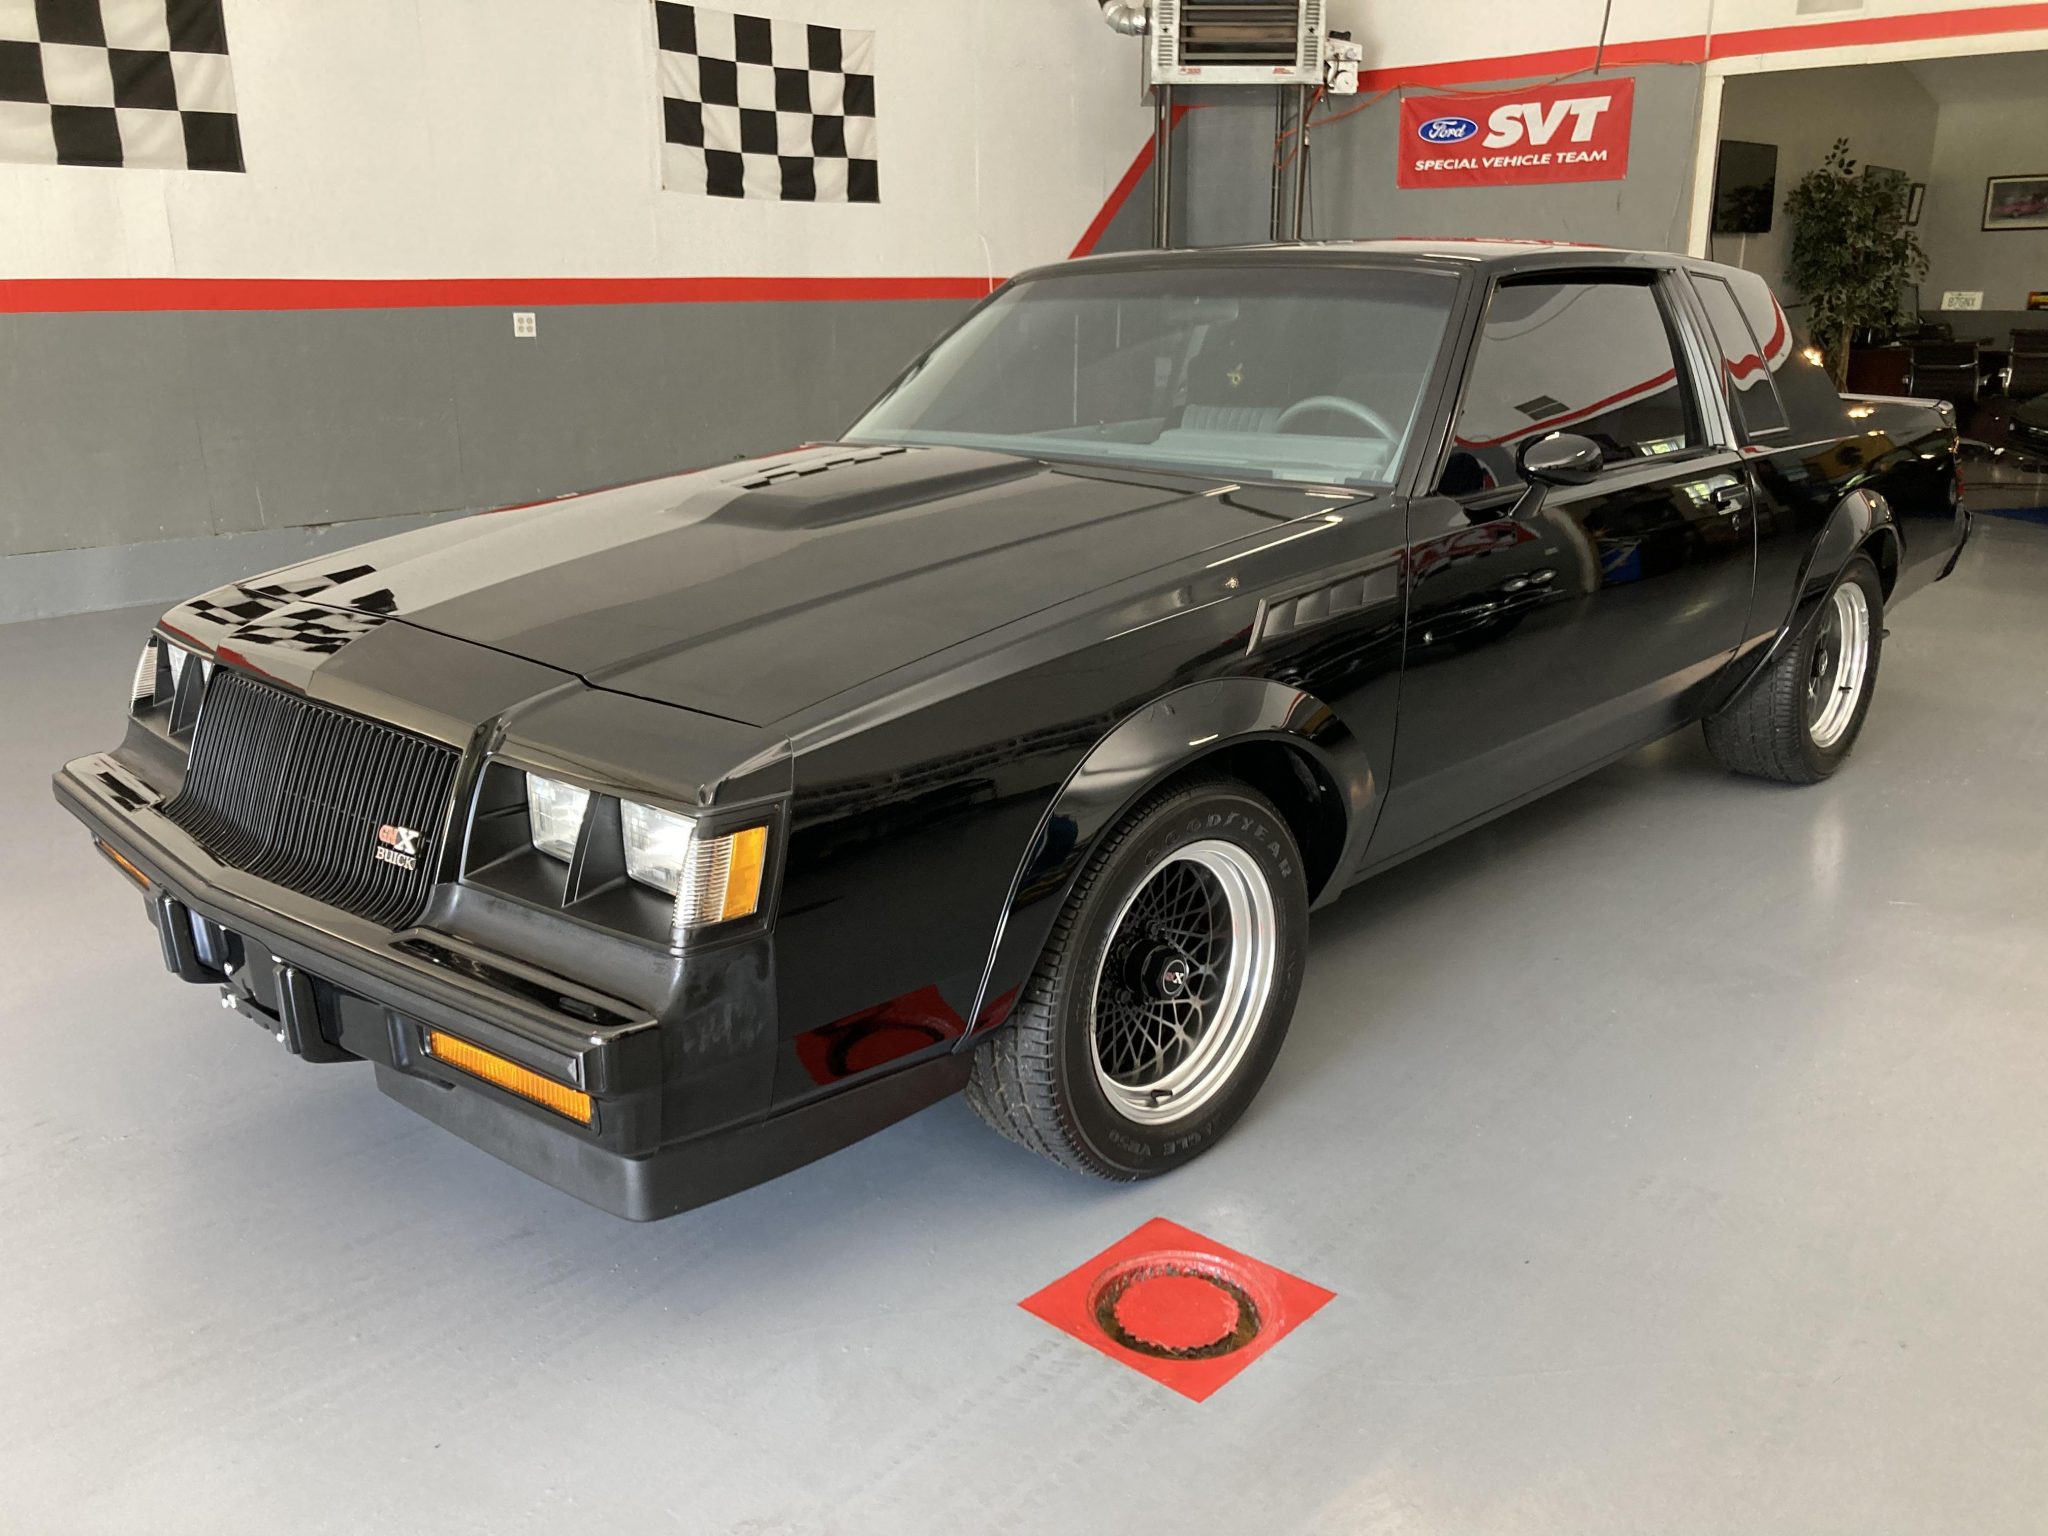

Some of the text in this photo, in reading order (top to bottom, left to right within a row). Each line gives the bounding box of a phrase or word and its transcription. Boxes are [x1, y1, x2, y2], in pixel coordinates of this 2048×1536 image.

[1428, 96, 1612, 149] Ford SVT
[1415, 150, 1608, 171] SPECIAL VEHICLE TEAM
[375, 846, 417, 871] BUICK
